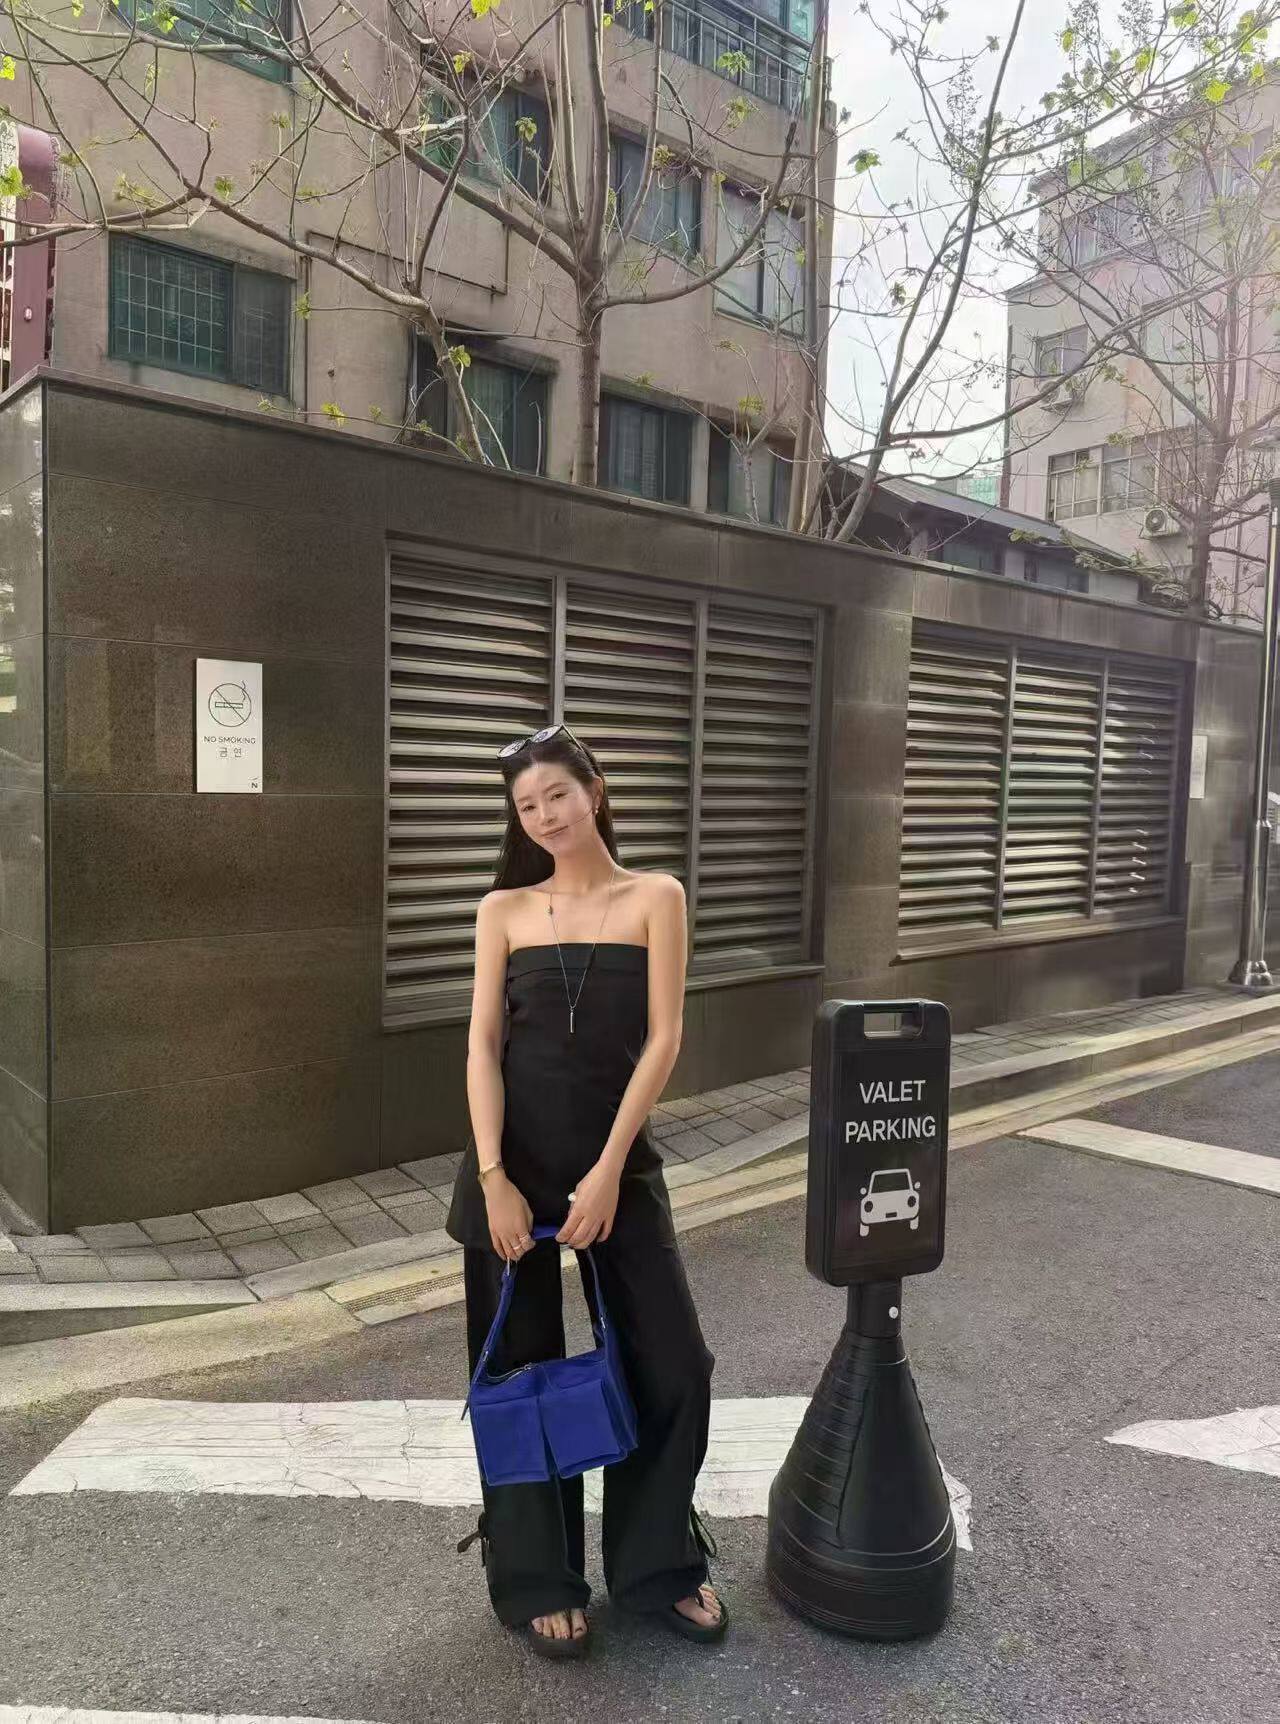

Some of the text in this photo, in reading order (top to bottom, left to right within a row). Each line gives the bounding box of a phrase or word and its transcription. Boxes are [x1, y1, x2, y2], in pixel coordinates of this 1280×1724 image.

[203, 735, 256, 744] NO SMOKING
[859, 1079, 926, 1104] VALET
[845, 1115, 936, 1143] PARKING
